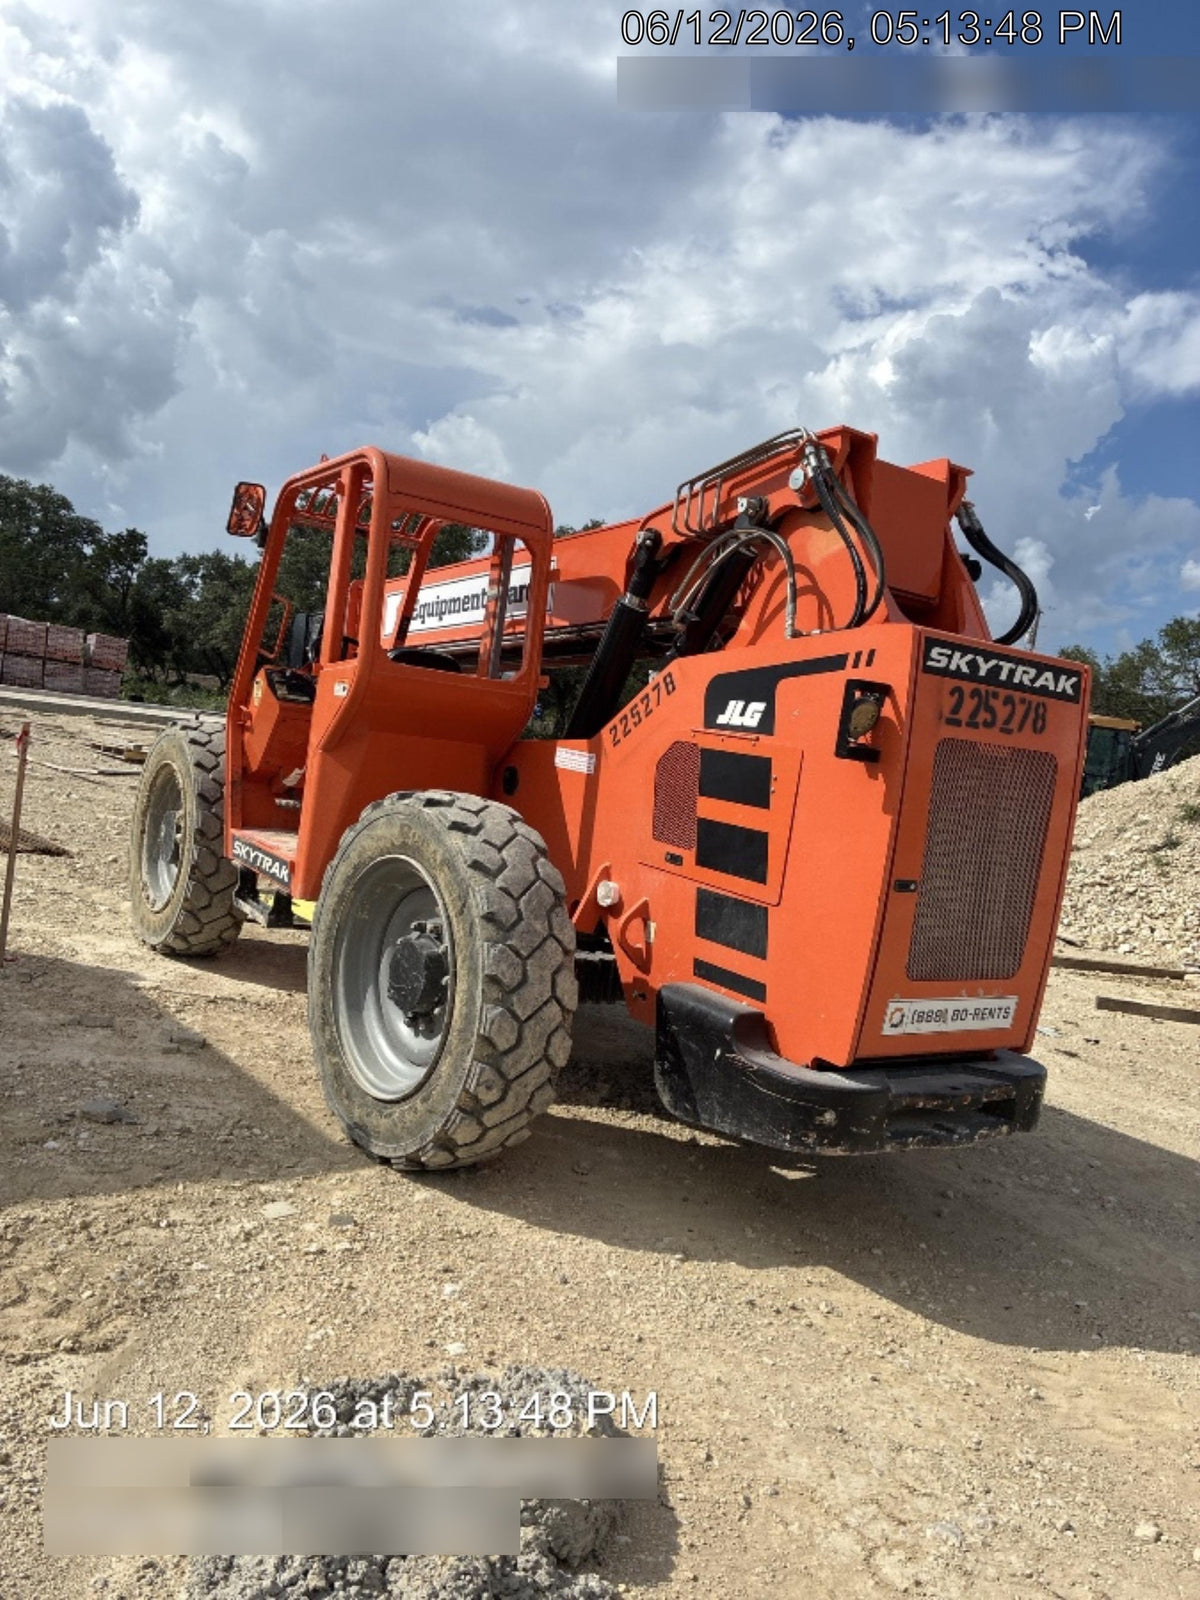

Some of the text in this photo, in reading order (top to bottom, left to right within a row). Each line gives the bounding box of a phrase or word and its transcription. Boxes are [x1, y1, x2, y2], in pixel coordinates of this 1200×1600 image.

[926, 646, 1079, 696] SKYTRAK
[609, 671, 677, 747] 225278
[716, 700, 767, 728] JLG
[944, 686, 1047, 735] 225278
[232, 840, 289, 883] SKYTRAK
